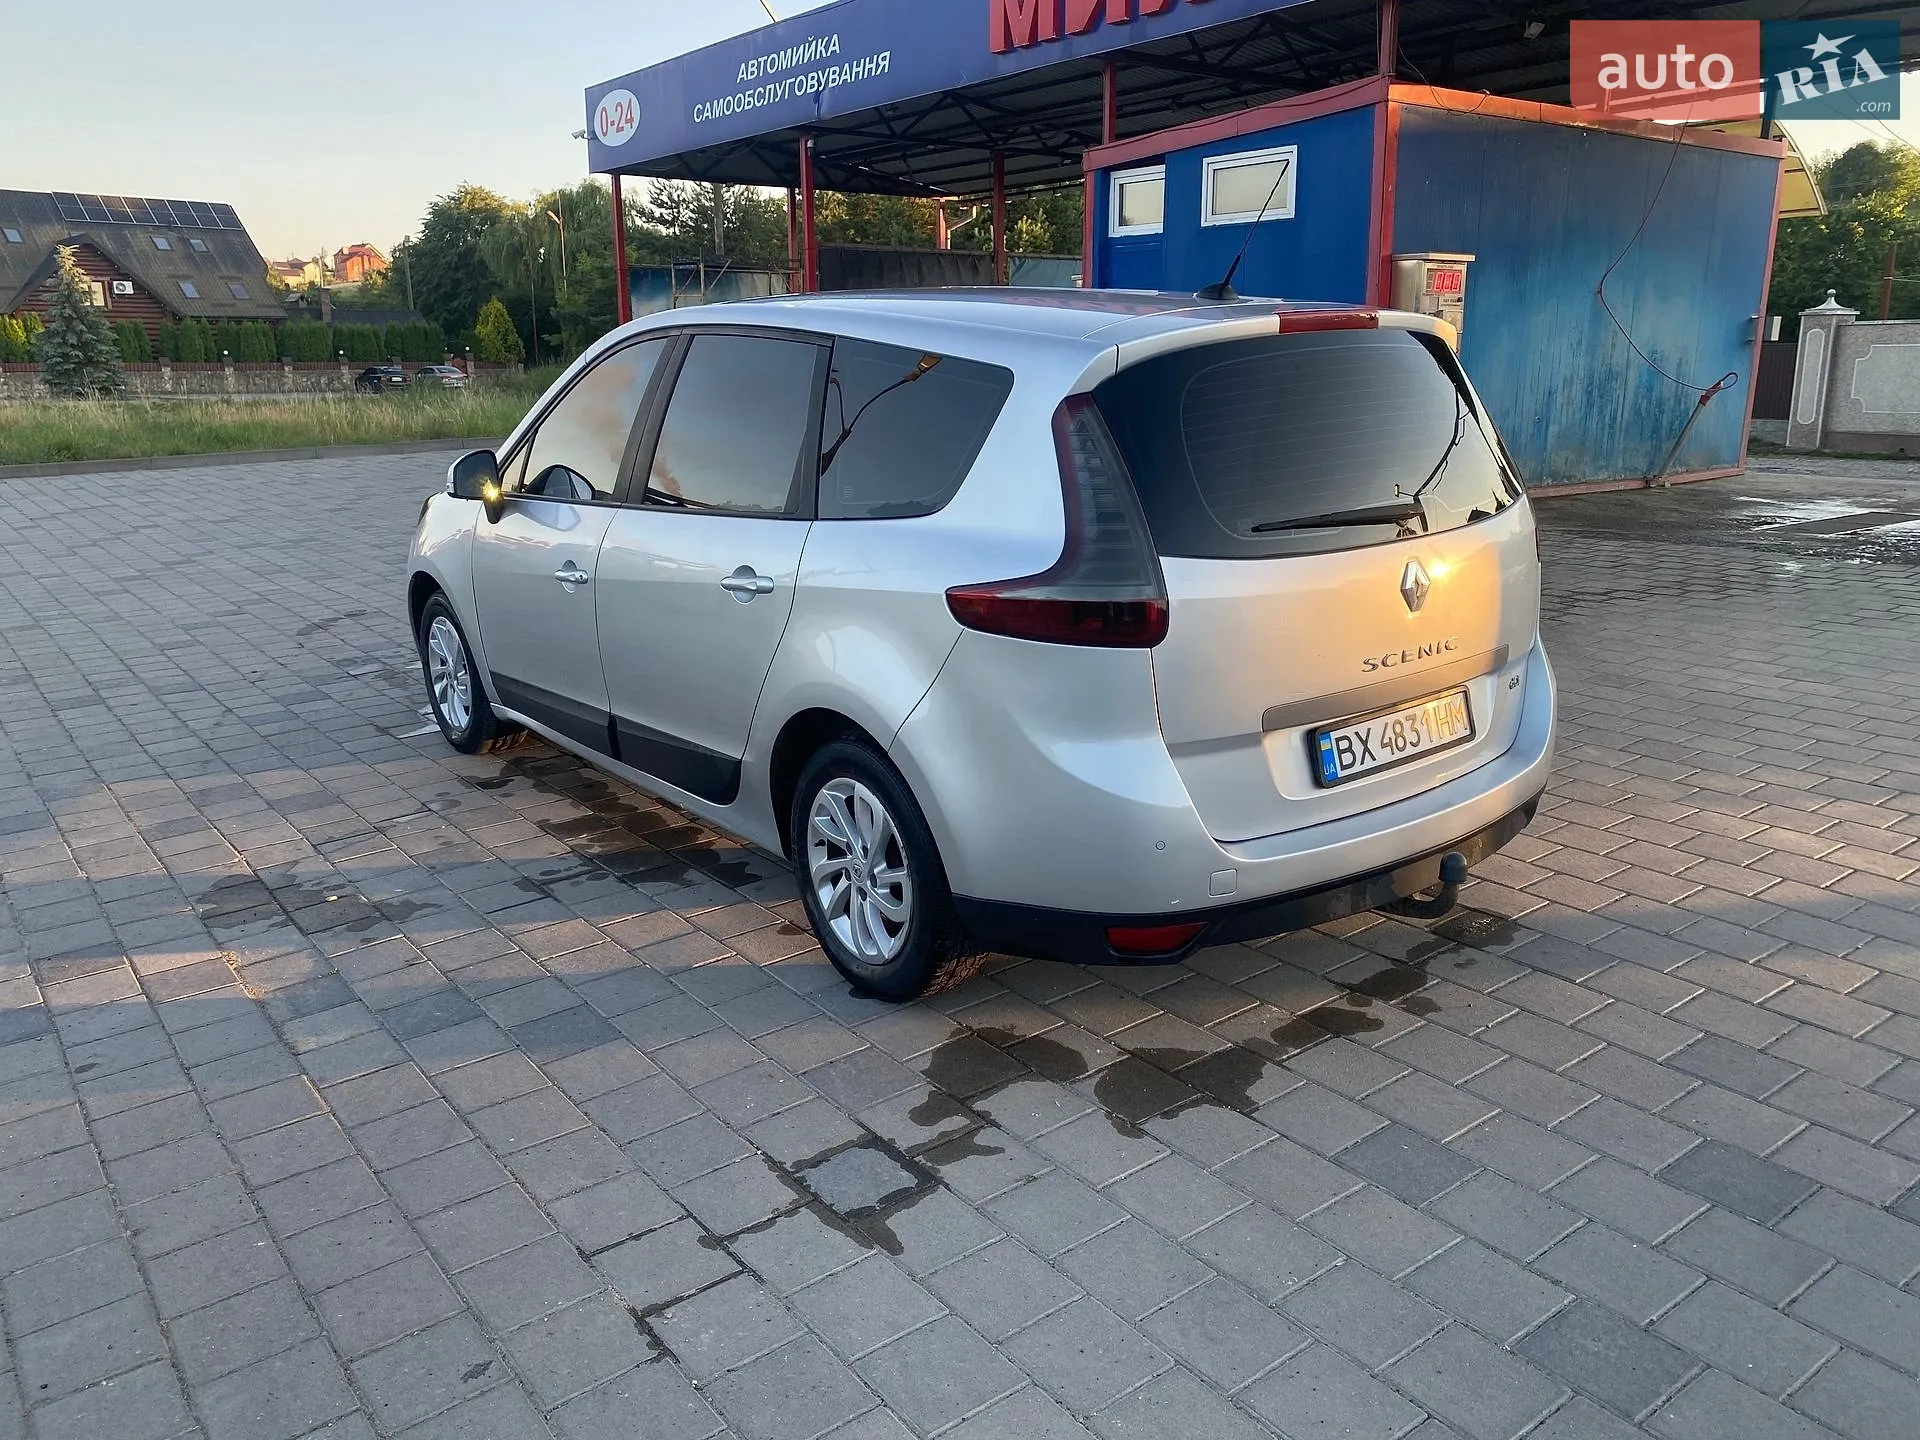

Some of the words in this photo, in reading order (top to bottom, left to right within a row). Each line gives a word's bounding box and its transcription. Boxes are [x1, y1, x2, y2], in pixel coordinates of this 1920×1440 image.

[736, 33, 841, 84] АВТОМИЙКА
[693, 51, 891, 124] САМООБСЛУГОВУВАННЯ
[599, 97, 635, 138] 0-24
[1361, 635, 1460, 673] SCENIC
[1323, 763, 1337, 776] UA
[1335, 727, 1377, 772] BX
